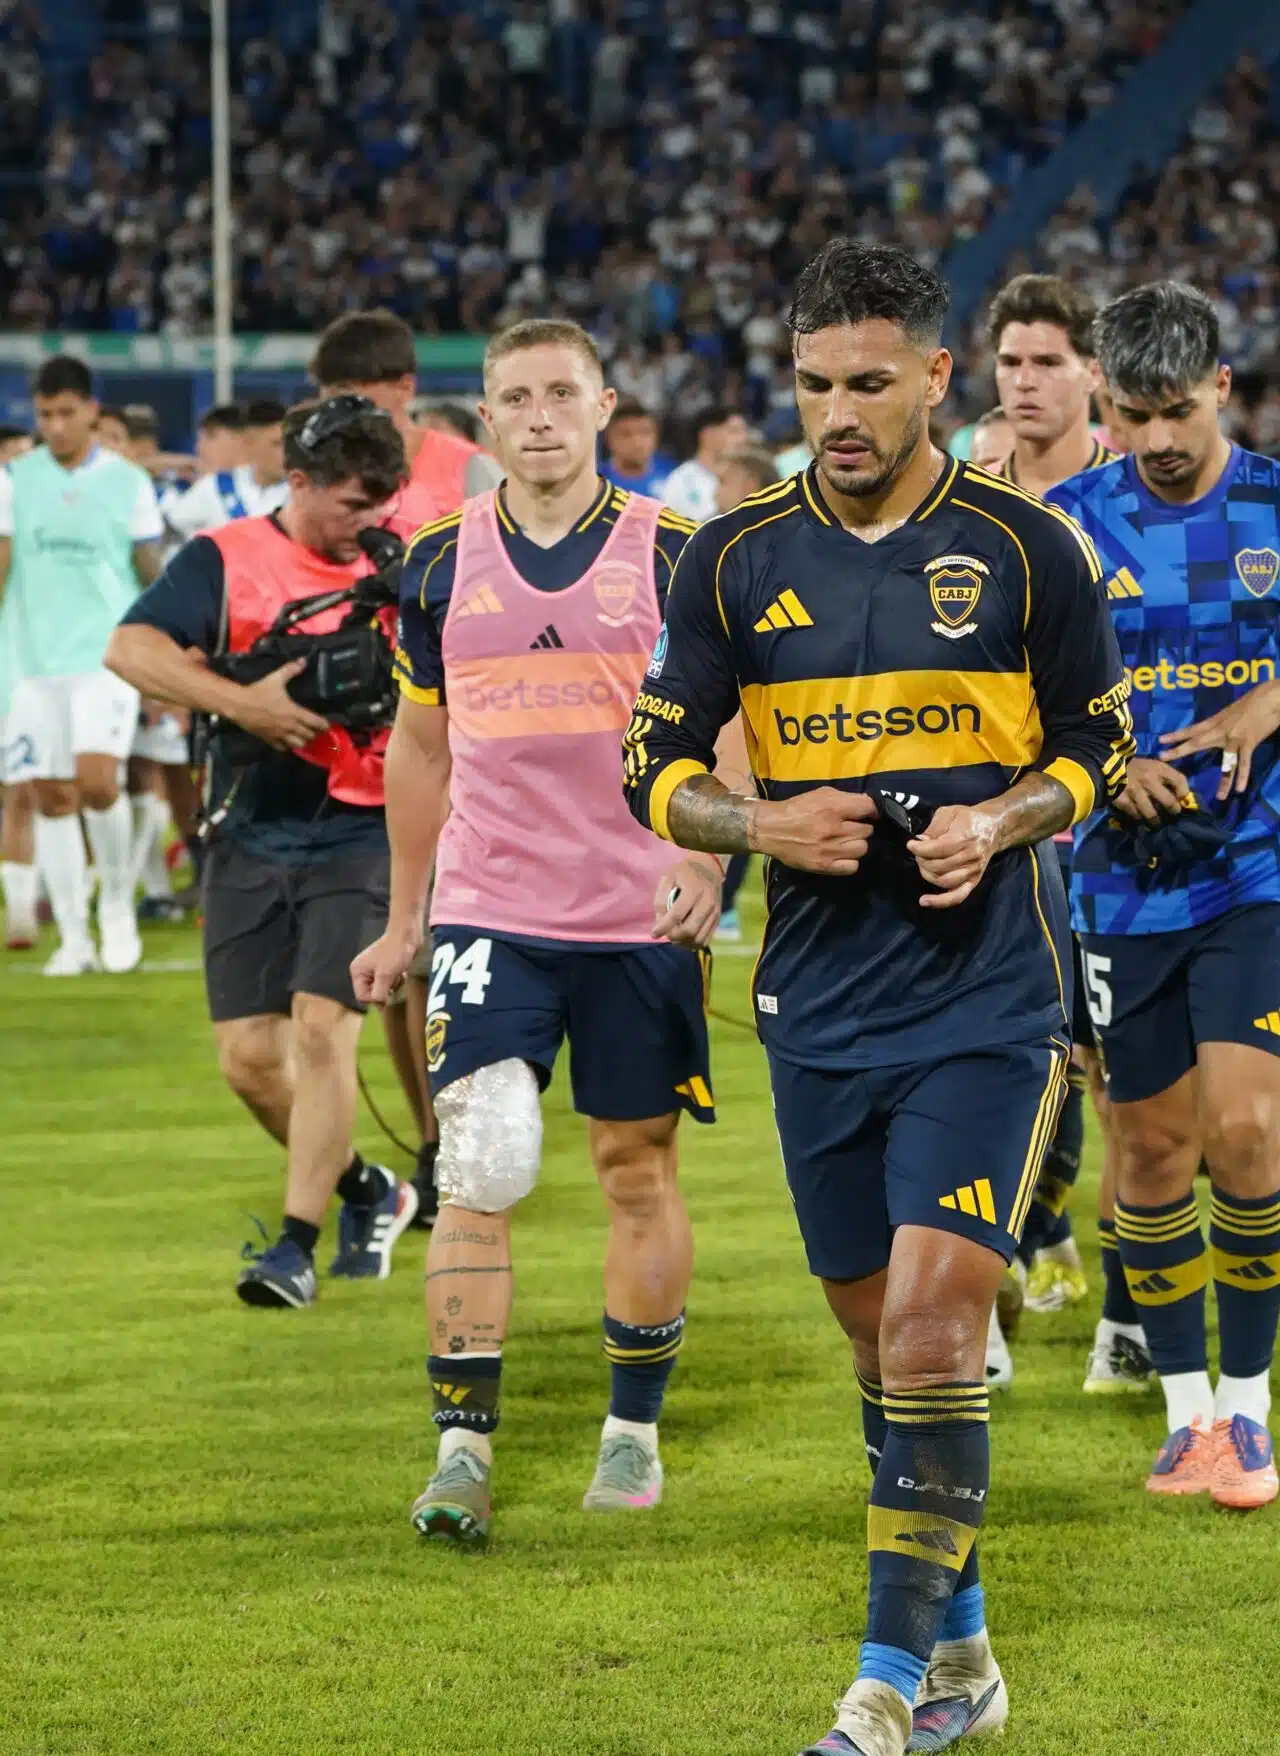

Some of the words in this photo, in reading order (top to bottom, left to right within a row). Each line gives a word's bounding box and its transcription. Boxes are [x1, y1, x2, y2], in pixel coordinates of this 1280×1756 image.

[1242, 563, 1273, 575] CABJ
[938, 589, 972, 599] CABJ
[773, 703, 981, 746] betsson
[427, 938, 492, 1015] 24
[897, 1476, 986, 1502] CABJ
